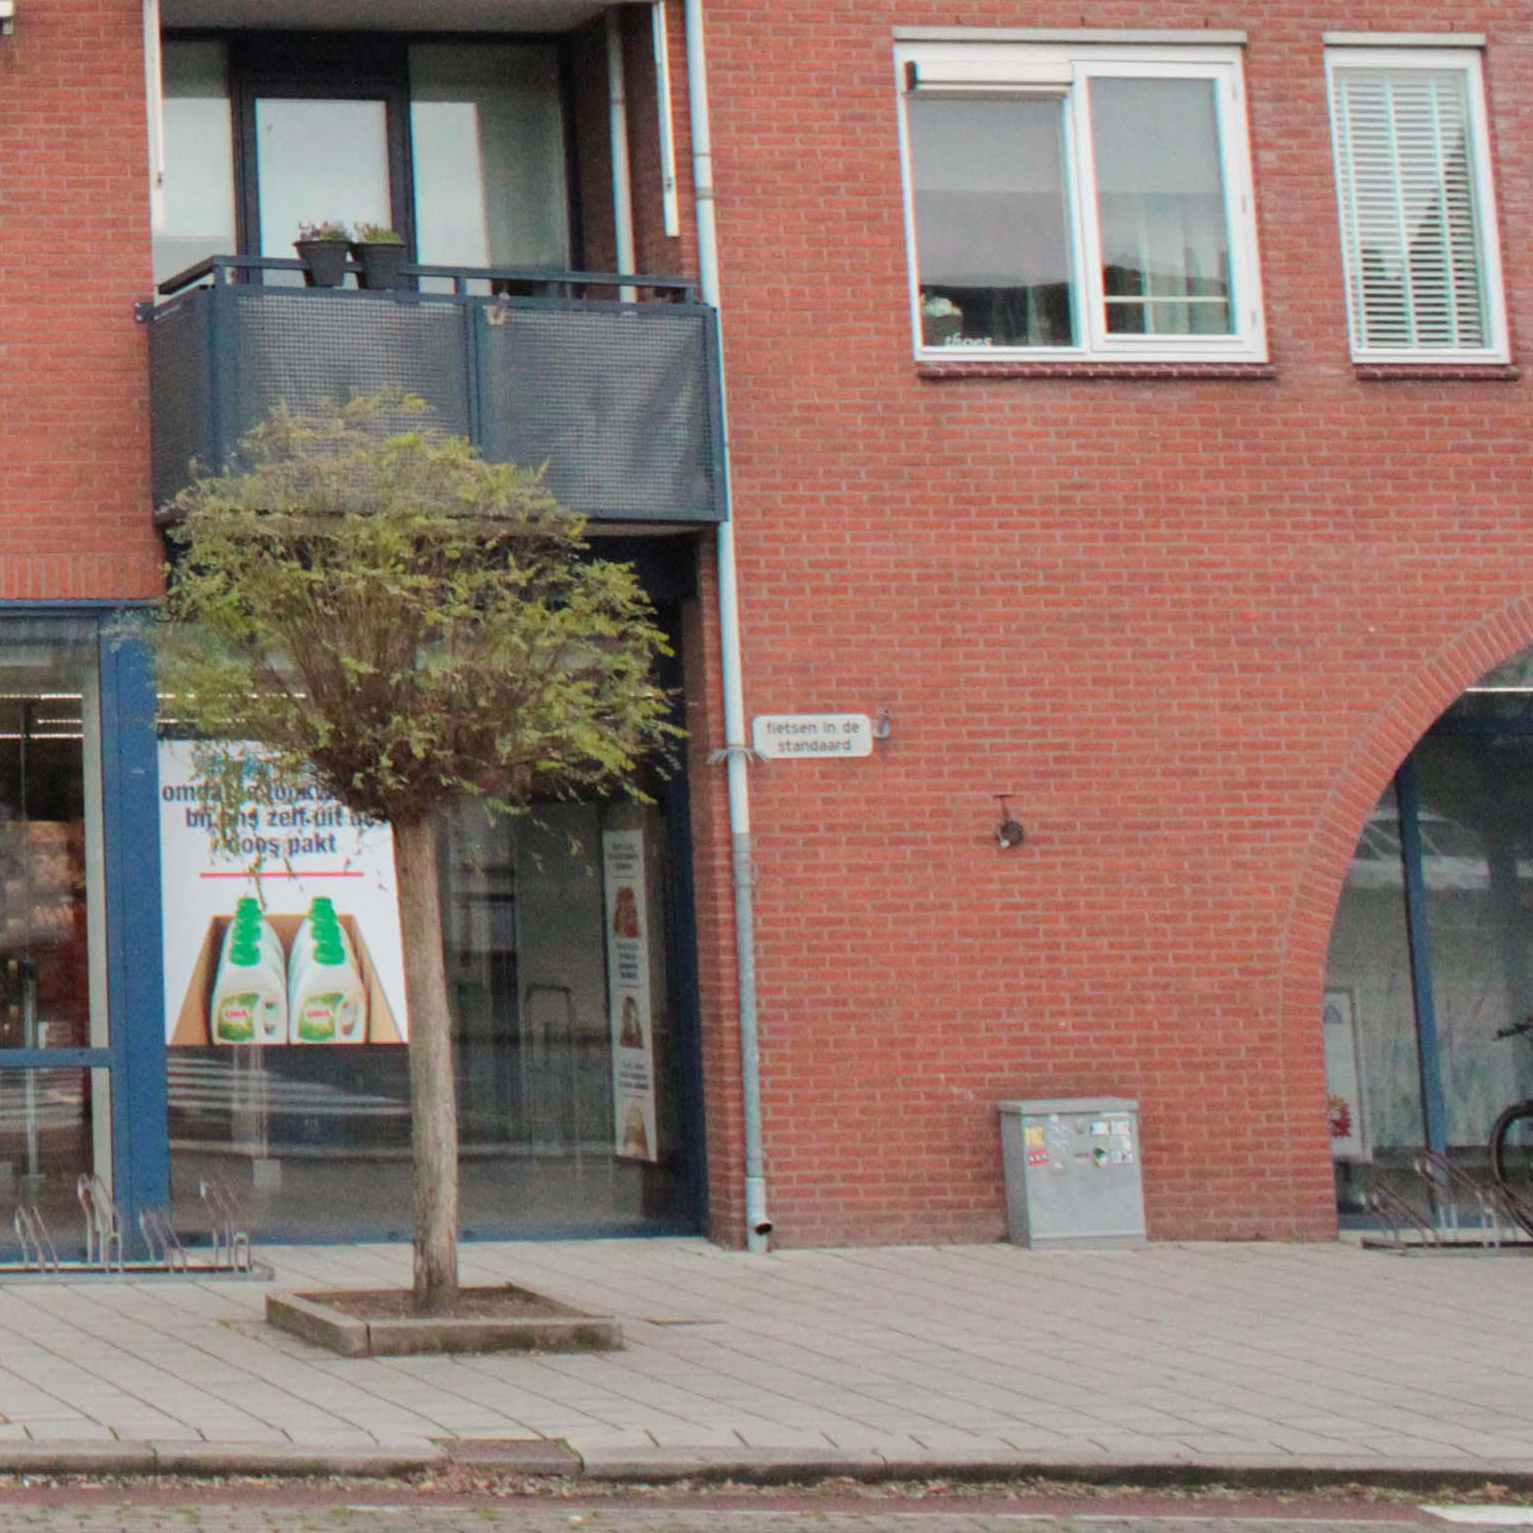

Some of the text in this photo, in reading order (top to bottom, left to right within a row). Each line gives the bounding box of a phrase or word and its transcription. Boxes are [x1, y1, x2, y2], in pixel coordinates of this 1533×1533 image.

[765, 720, 860, 734] fietsen in de
[777, 738, 852, 753] standaard
[266, 804, 307, 827] zelf
[314, 803, 343, 827] uit
[288, 832, 337, 857] pakt
